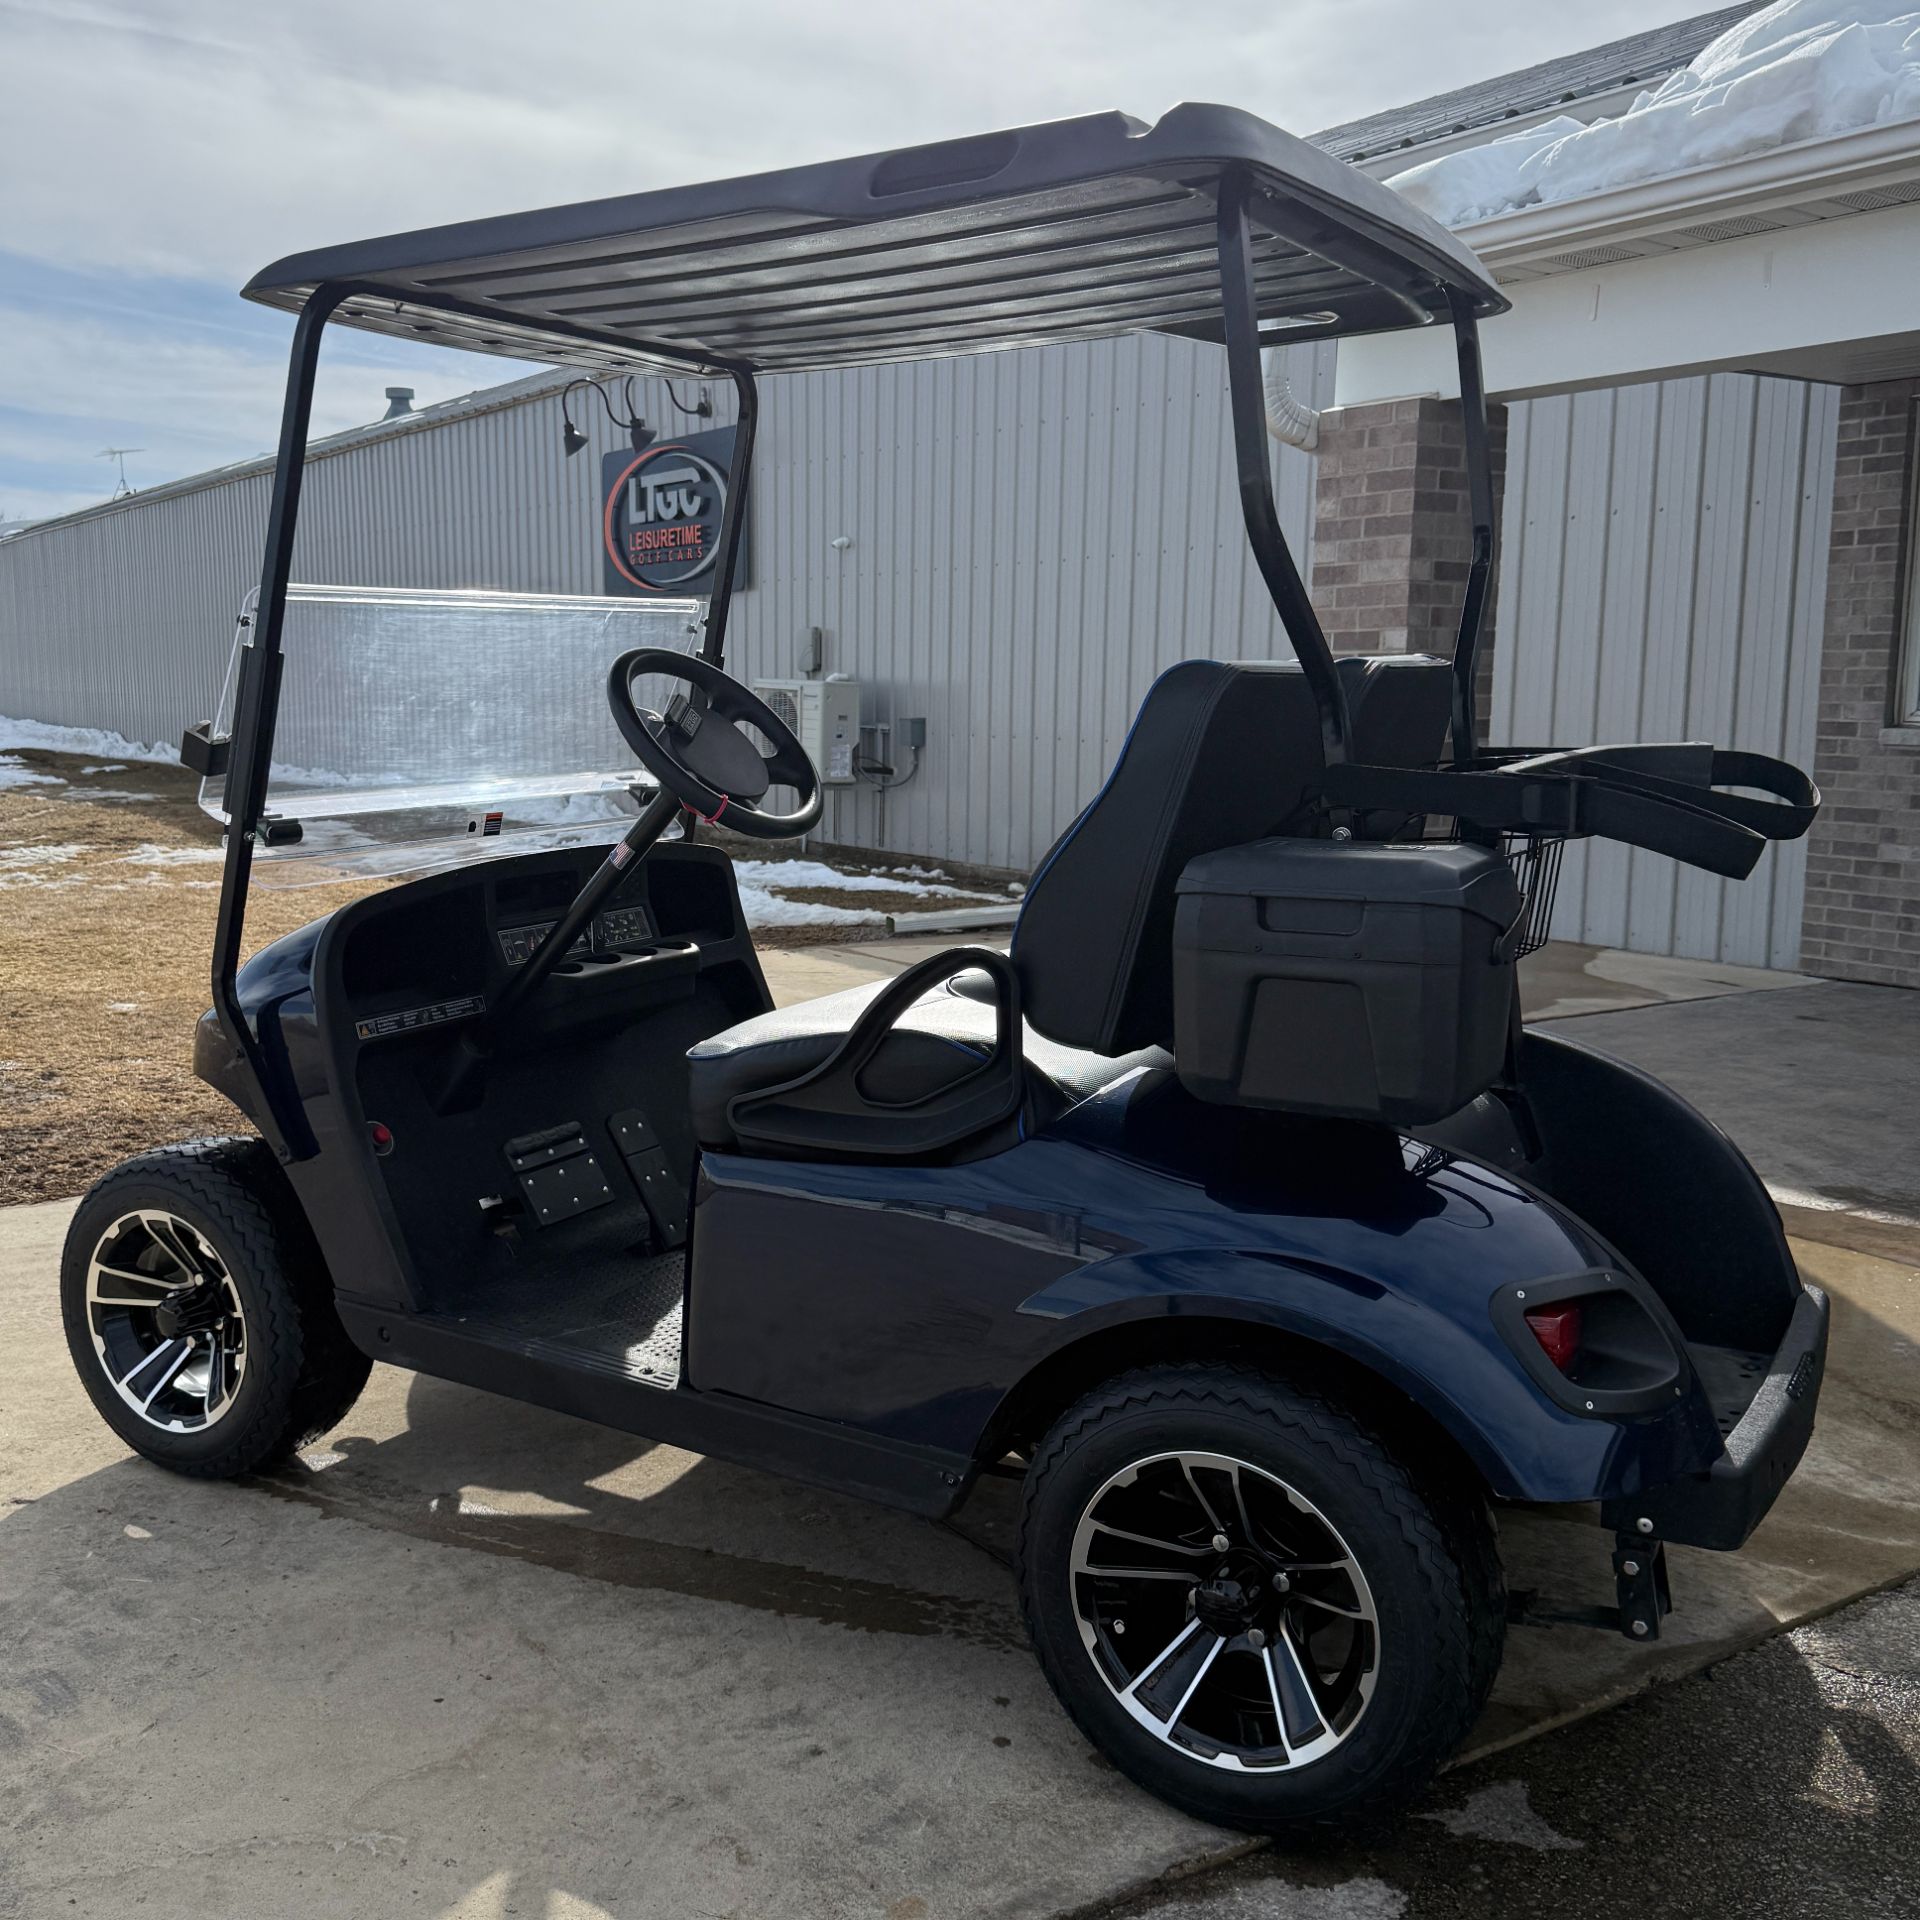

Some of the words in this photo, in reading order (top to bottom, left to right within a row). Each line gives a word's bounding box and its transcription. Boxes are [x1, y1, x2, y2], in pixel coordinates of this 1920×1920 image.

[628, 467, 702, 525] LTGC
[629, 524, 702, 551] LEISURETIME
[630, 550, 661, 566] GOLF
[668, 546, 703, 562] CARS
